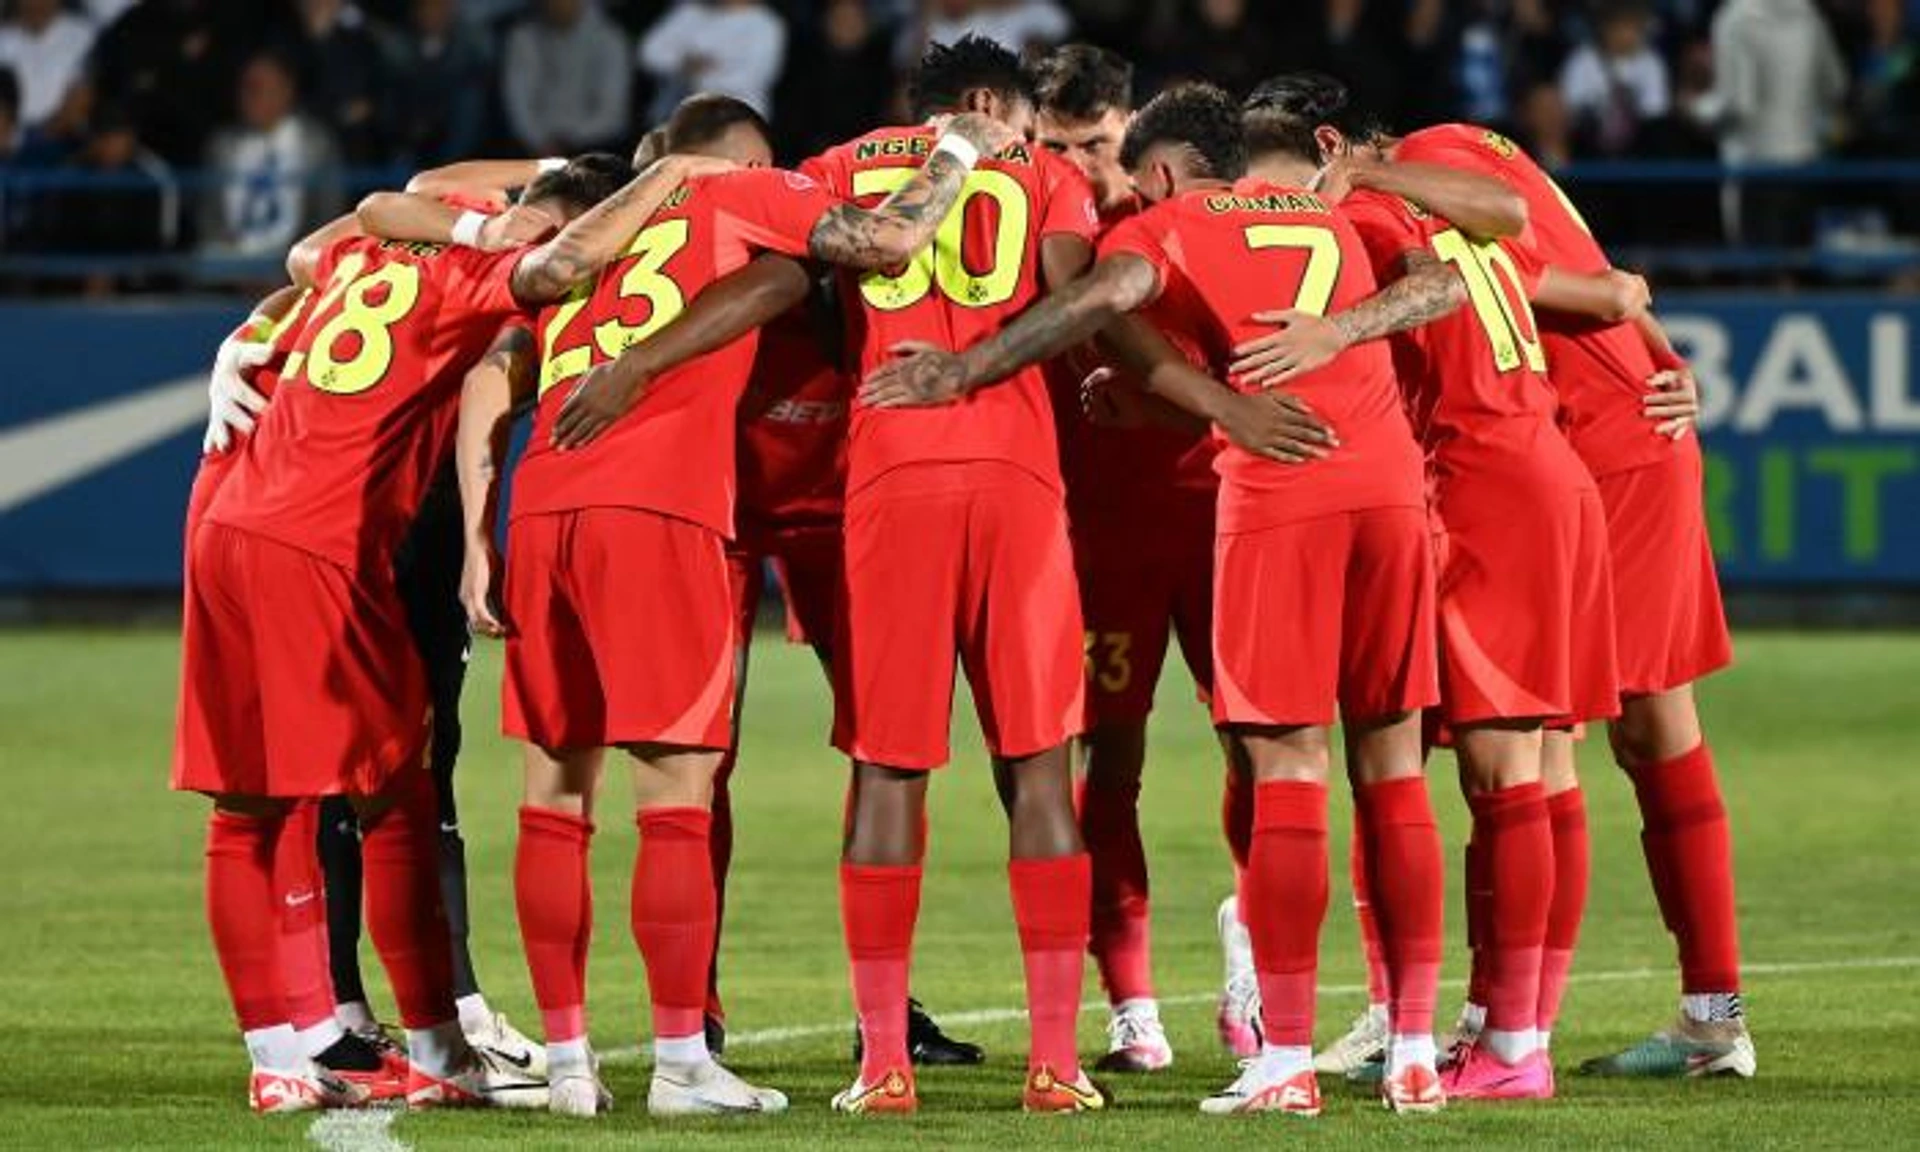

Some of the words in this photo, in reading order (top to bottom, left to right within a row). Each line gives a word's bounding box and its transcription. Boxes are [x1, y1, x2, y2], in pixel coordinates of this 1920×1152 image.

[280, 251, 421, 395] 28
[1243, 222, 1343, 317] 7
[1431, 227, 1548, 373] 10
